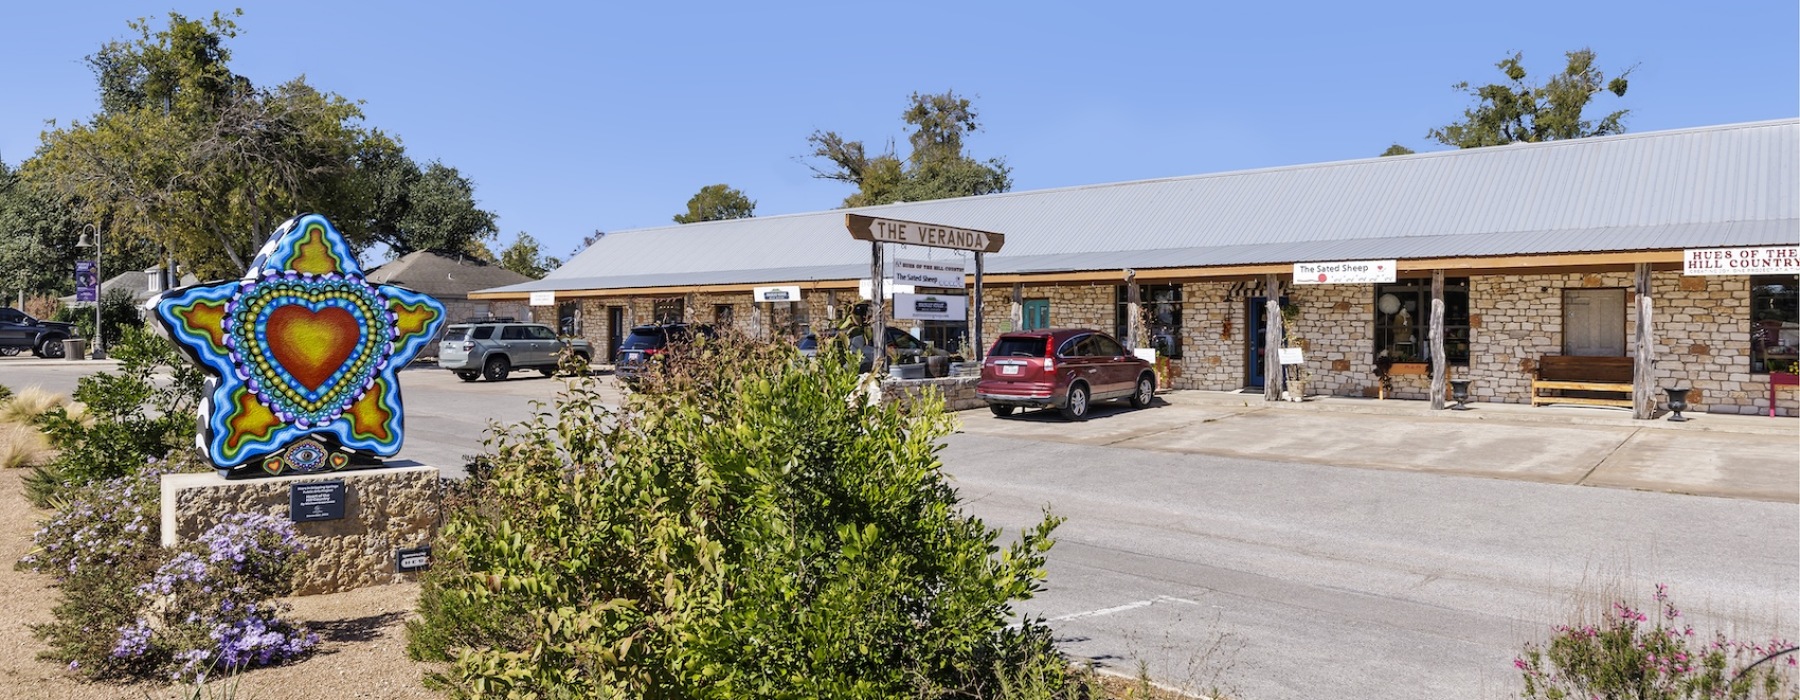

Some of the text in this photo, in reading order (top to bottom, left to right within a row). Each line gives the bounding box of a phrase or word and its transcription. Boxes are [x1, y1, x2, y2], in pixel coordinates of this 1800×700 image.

[878, 222, 984, 248] THE VERANDA
[1693, 249, 1798, 260] HUES OF THE
[1688, 258, 1800, 268] HILL COUNTRY
[1316, 264, 1340, 273] Sated
[1342, 264, 1369, 273] Sheep
[923, 275, 938, 284] Sheep
